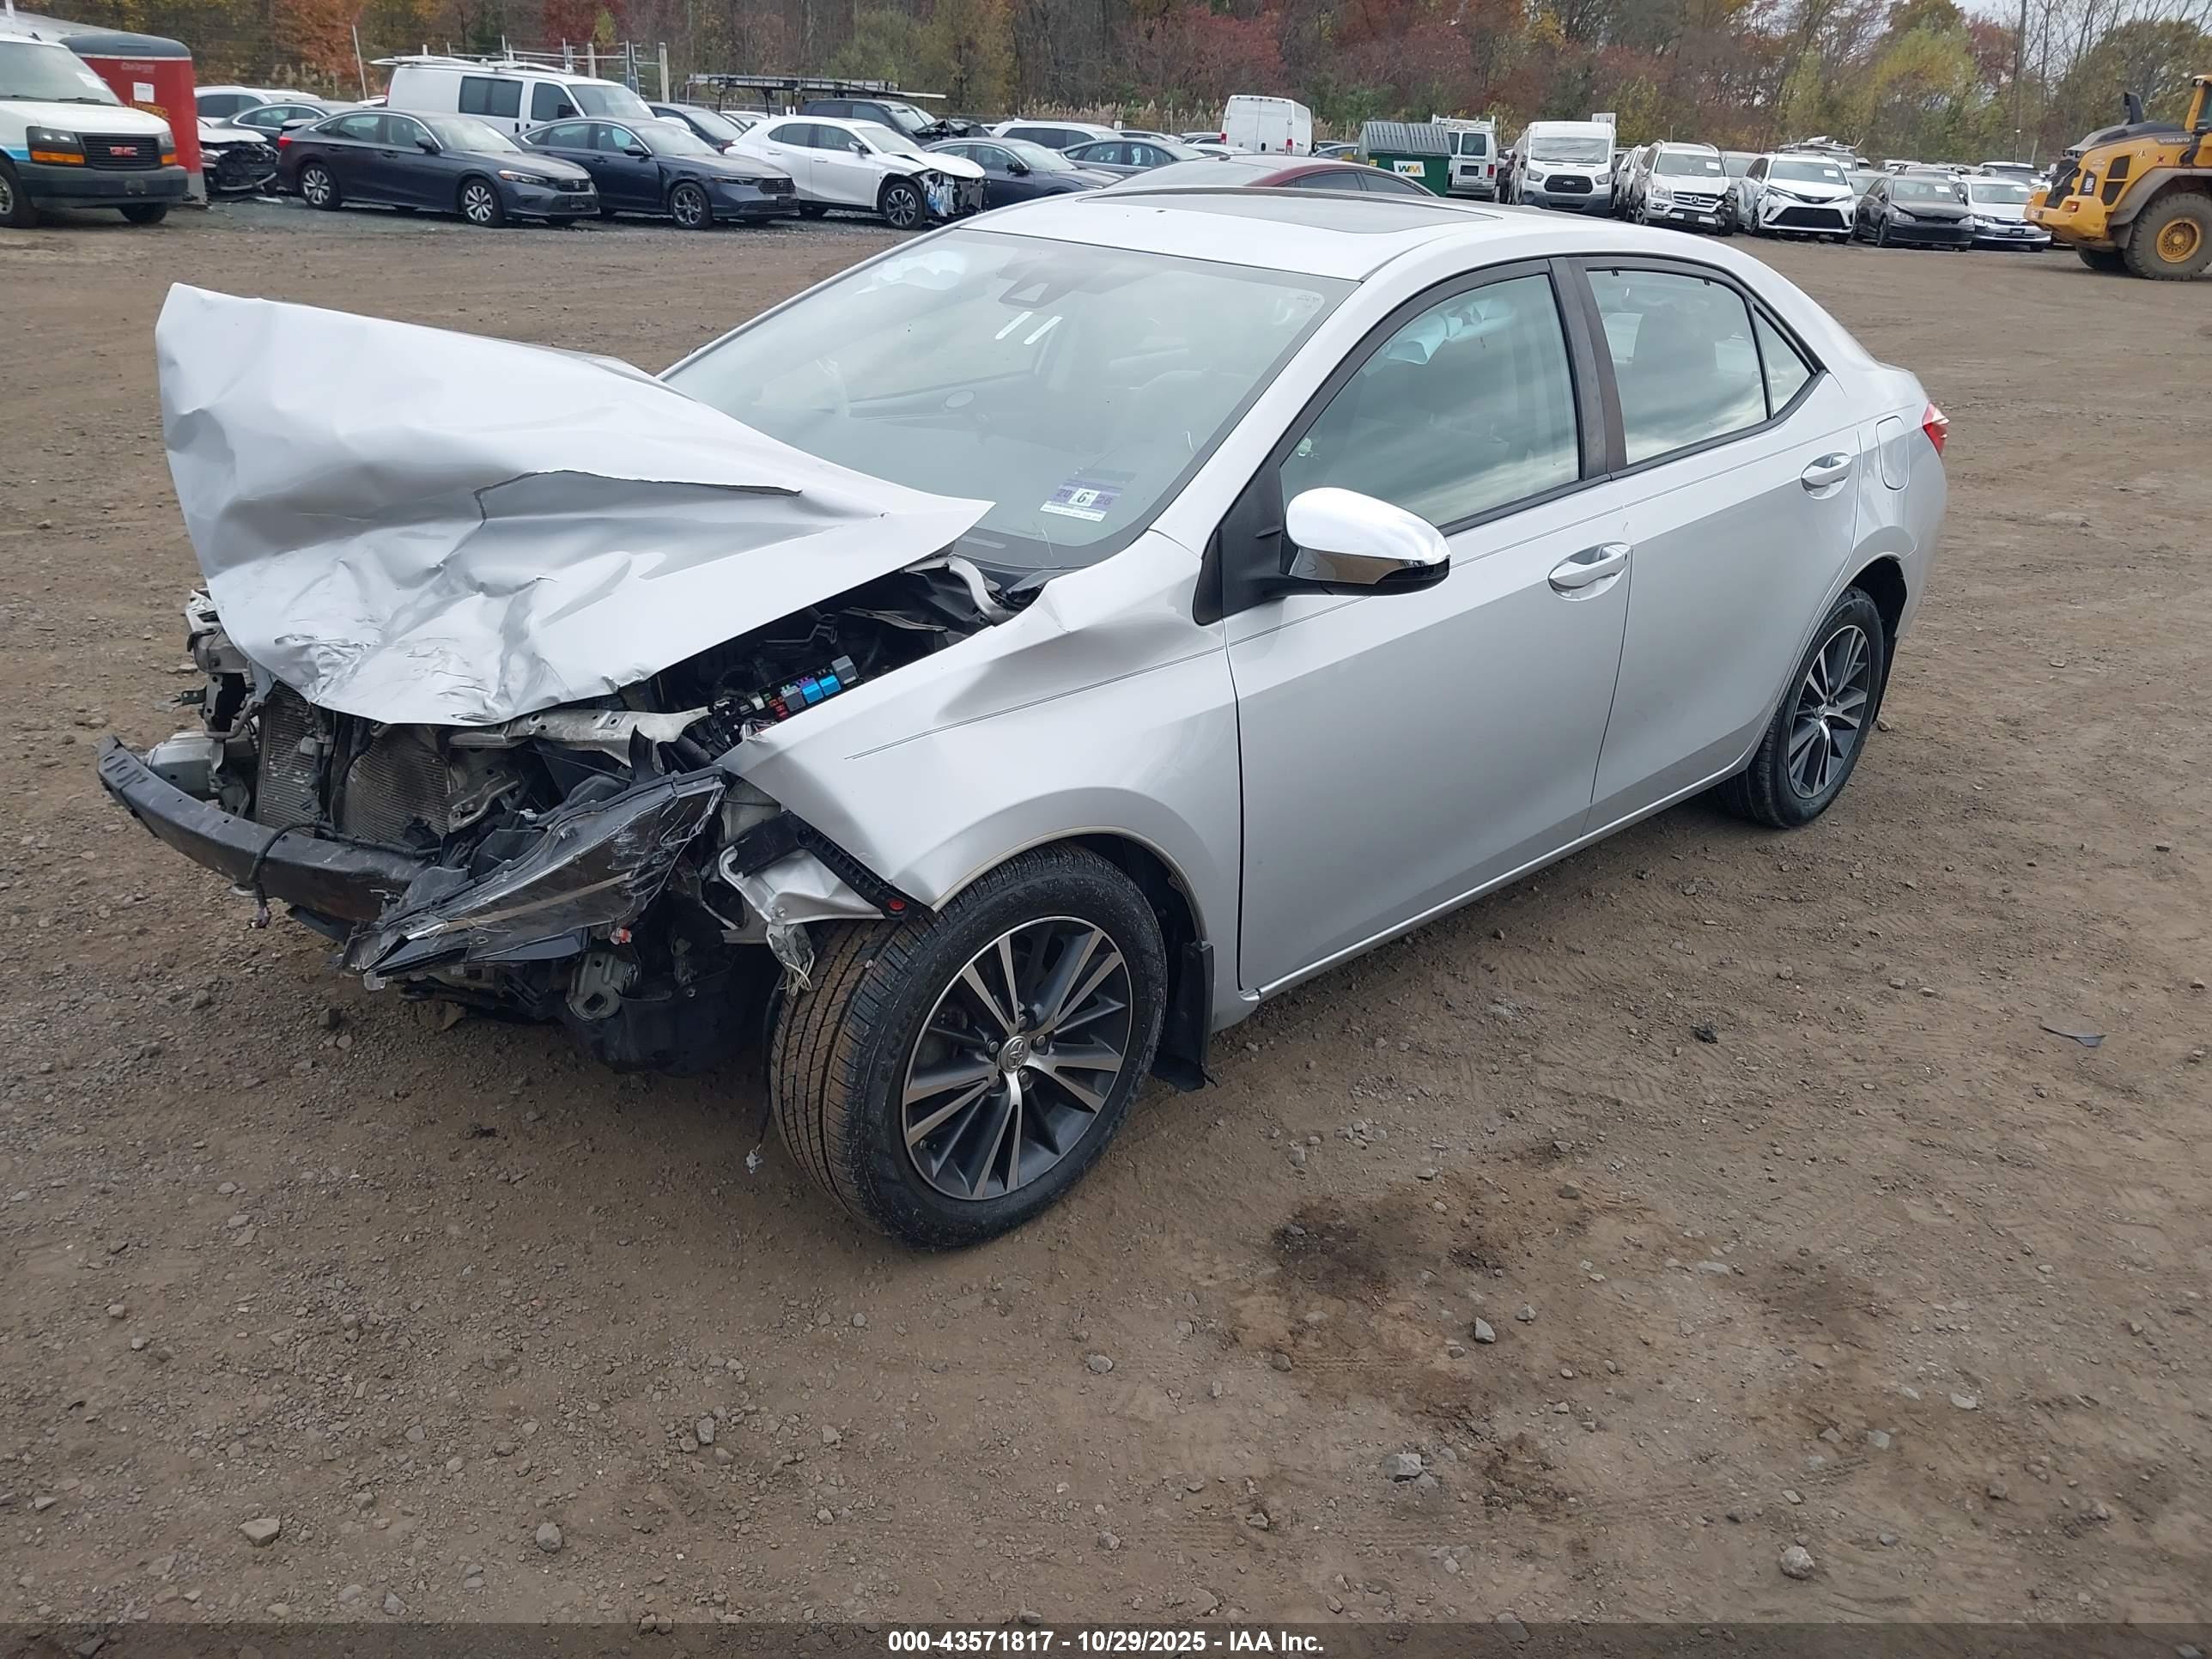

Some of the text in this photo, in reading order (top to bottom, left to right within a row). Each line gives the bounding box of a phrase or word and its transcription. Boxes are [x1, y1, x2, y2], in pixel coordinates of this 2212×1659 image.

[109, 146, 137, 155] GMC
[1398, 164, 1421, 173] WM
[1077, 492, 1090, 503] 6
